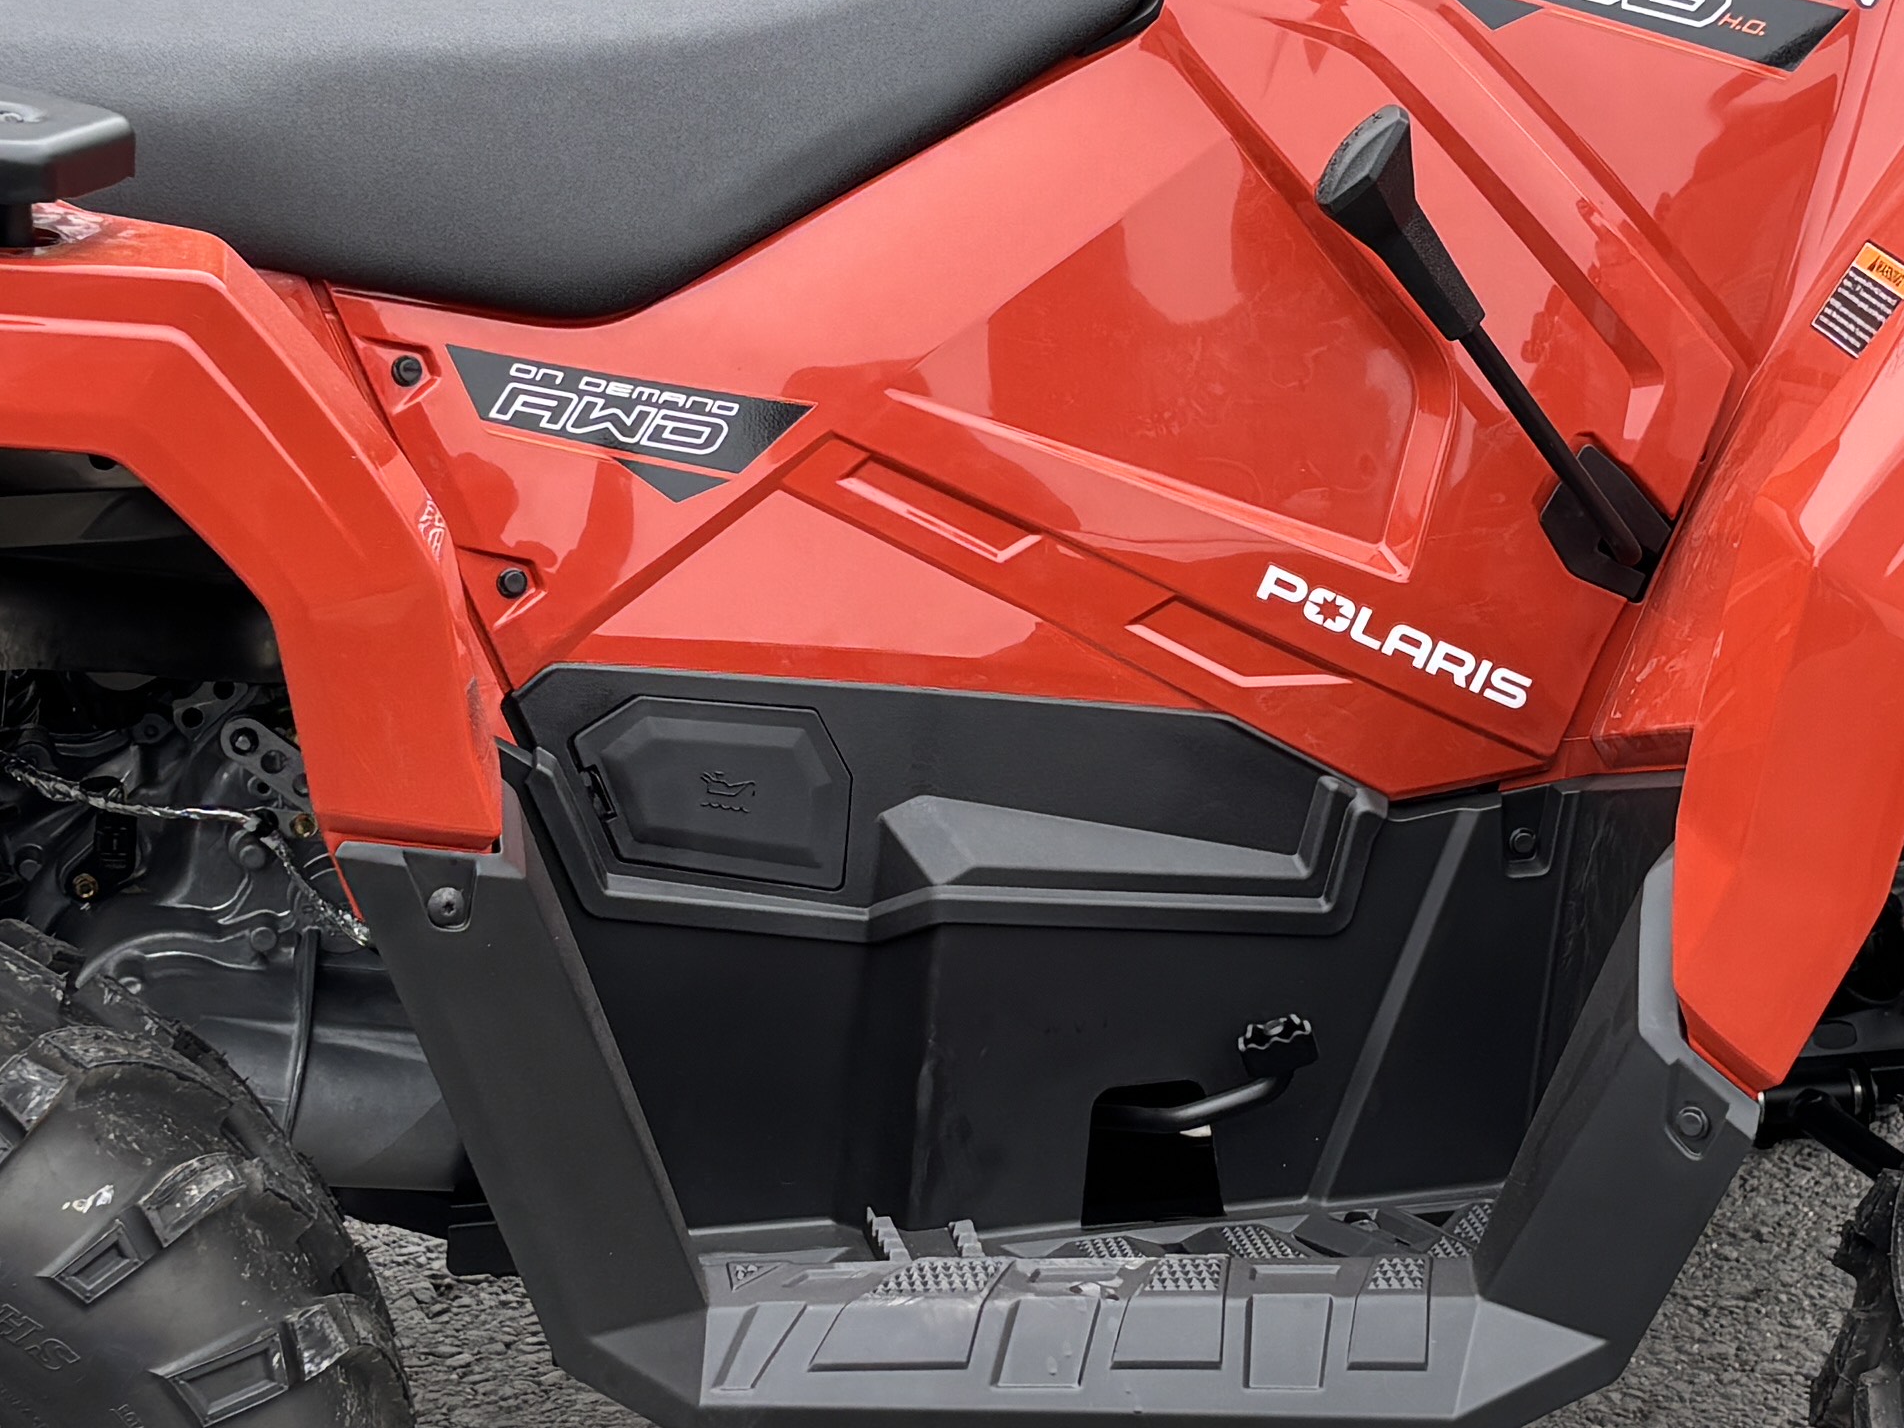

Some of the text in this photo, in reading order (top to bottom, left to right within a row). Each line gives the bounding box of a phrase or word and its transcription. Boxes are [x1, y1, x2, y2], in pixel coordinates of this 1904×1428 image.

[488, 381, 730, 456] AWD
[509, 362, 741, 417] ON DEMAND
[1255, 562, 1534, 712] POLARIS
